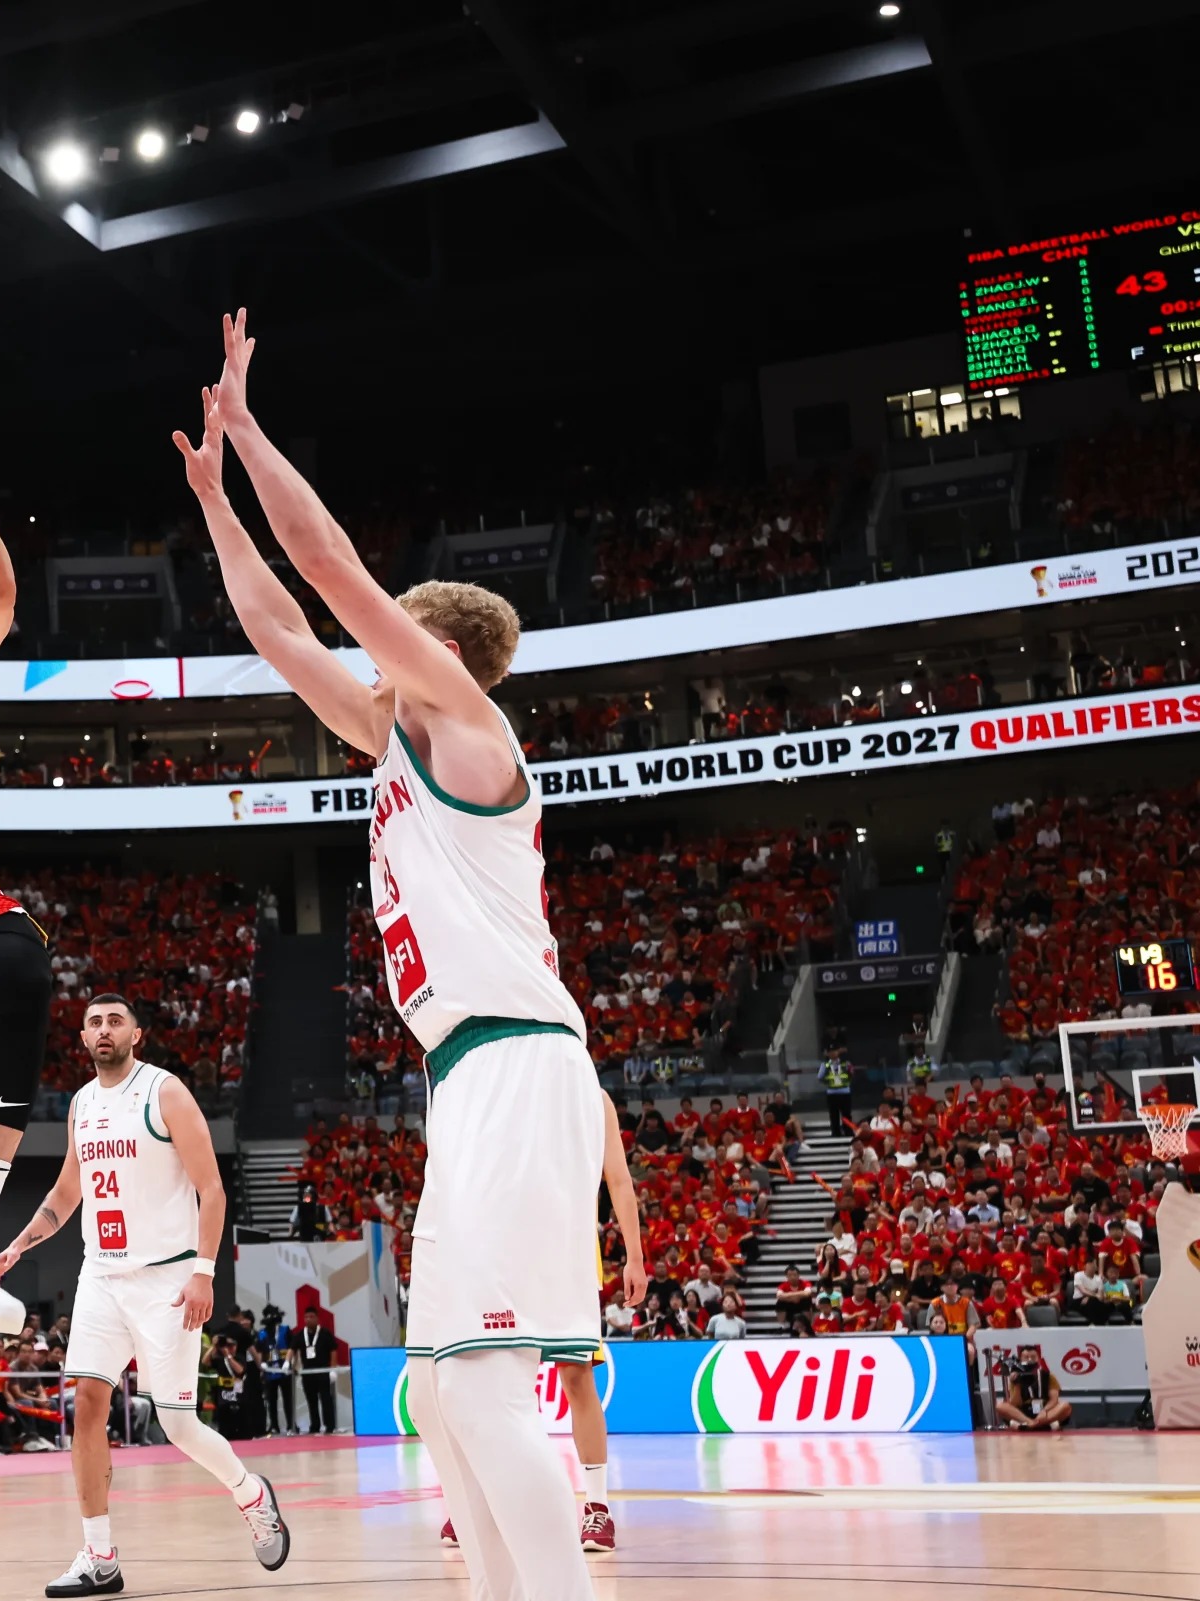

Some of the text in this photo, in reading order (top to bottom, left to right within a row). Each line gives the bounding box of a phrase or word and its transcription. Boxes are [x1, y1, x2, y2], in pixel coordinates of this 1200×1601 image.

[968, 249, 1004, 264] FIBA
[1008, 229, 1110, 256] BASKETBALL
[1113, 215, 1177, 235] WORLD
[1042, 245, 1088, 263] CHN
[1116, 270, 1168, 296] 43
[1126, 547, 1200, 581] 202
[311, 786, 375, 813] FIB
[636, 749, 764, 786] WORLD
[773, 737, 852, 770] CUP
[861, 724, 960, 760] 2027
[970, 694, 1200, 751] QUALIFIERS
[858, 921, 894, 938] 出口
[390, 938, 416, 980] CFI
[1147, 961, 1177, 991] 16
[91, 1170, 120, 1199] 24
[101, 1222, 122, 1238] CFI
[744, 1348, 876, 1421] Yili
